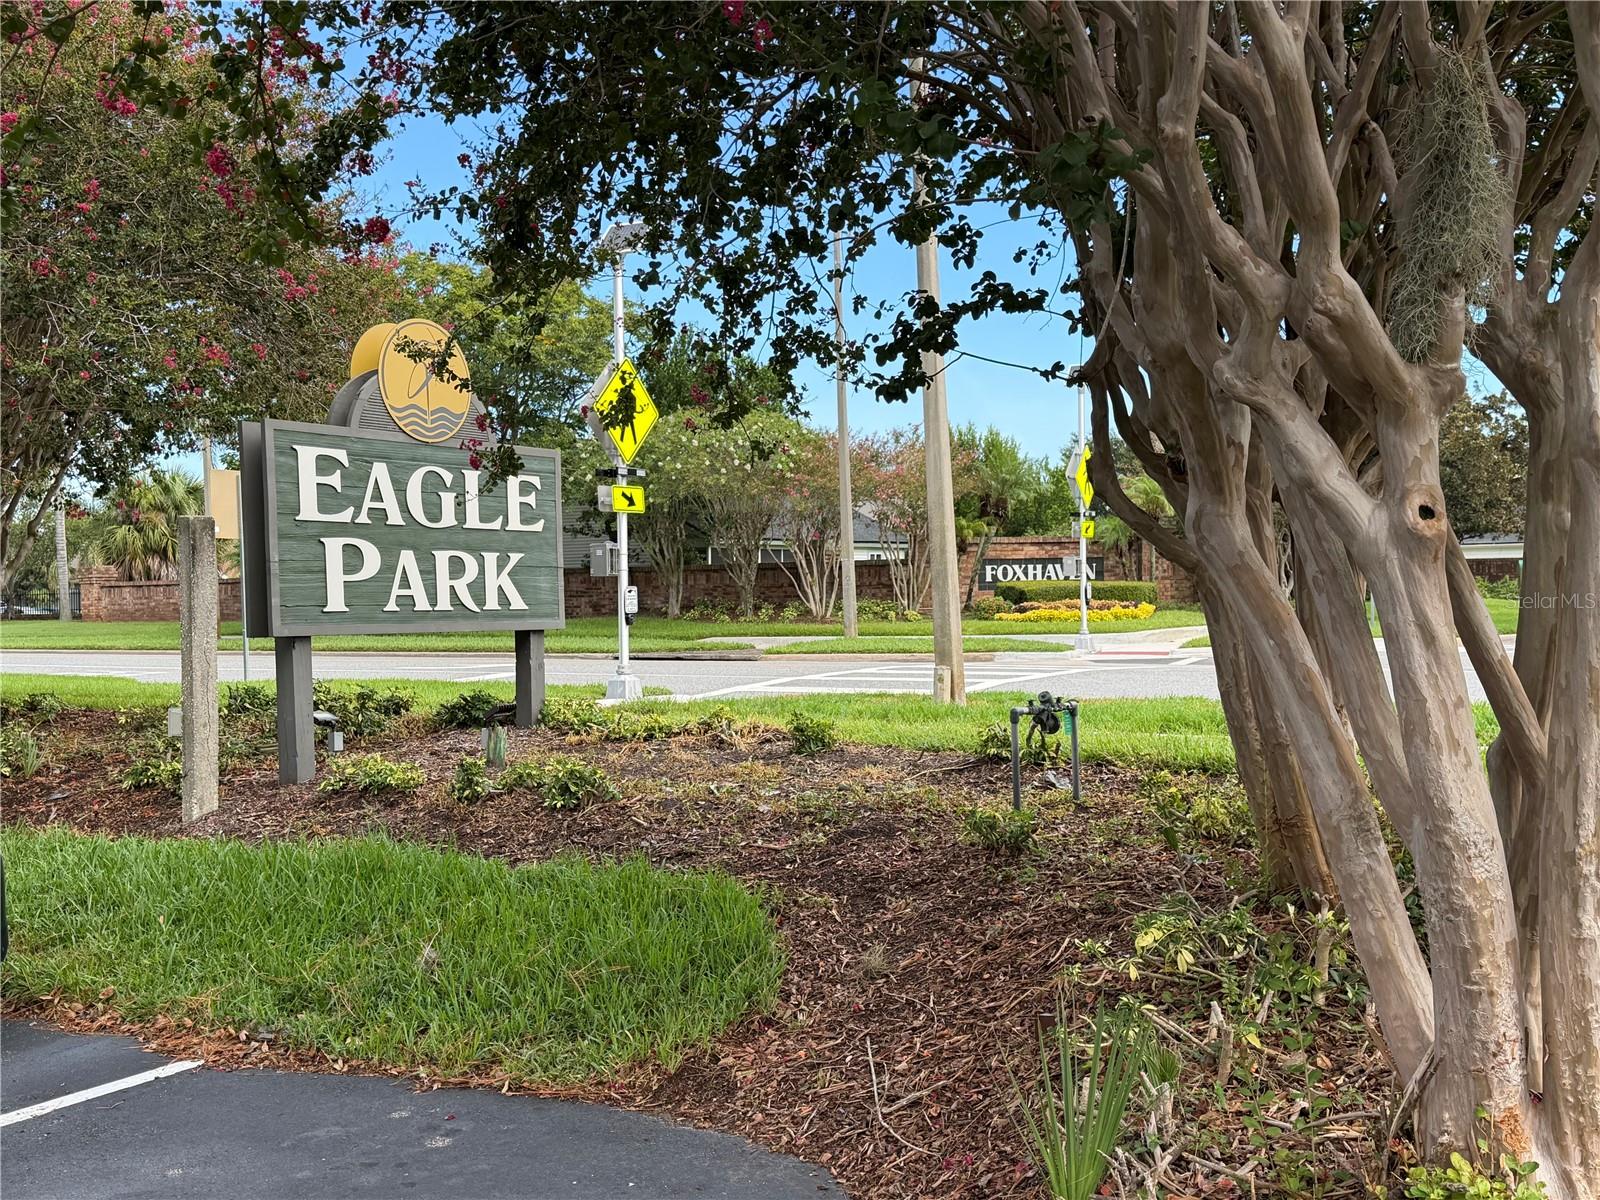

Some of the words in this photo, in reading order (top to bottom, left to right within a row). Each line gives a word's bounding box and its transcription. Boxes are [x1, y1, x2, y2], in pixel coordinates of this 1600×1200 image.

[292, 444, 545, 532] EAGLE
[319, 537, 529, 613] PARK
[985, 563, 1096, 582] FOXHAVN
